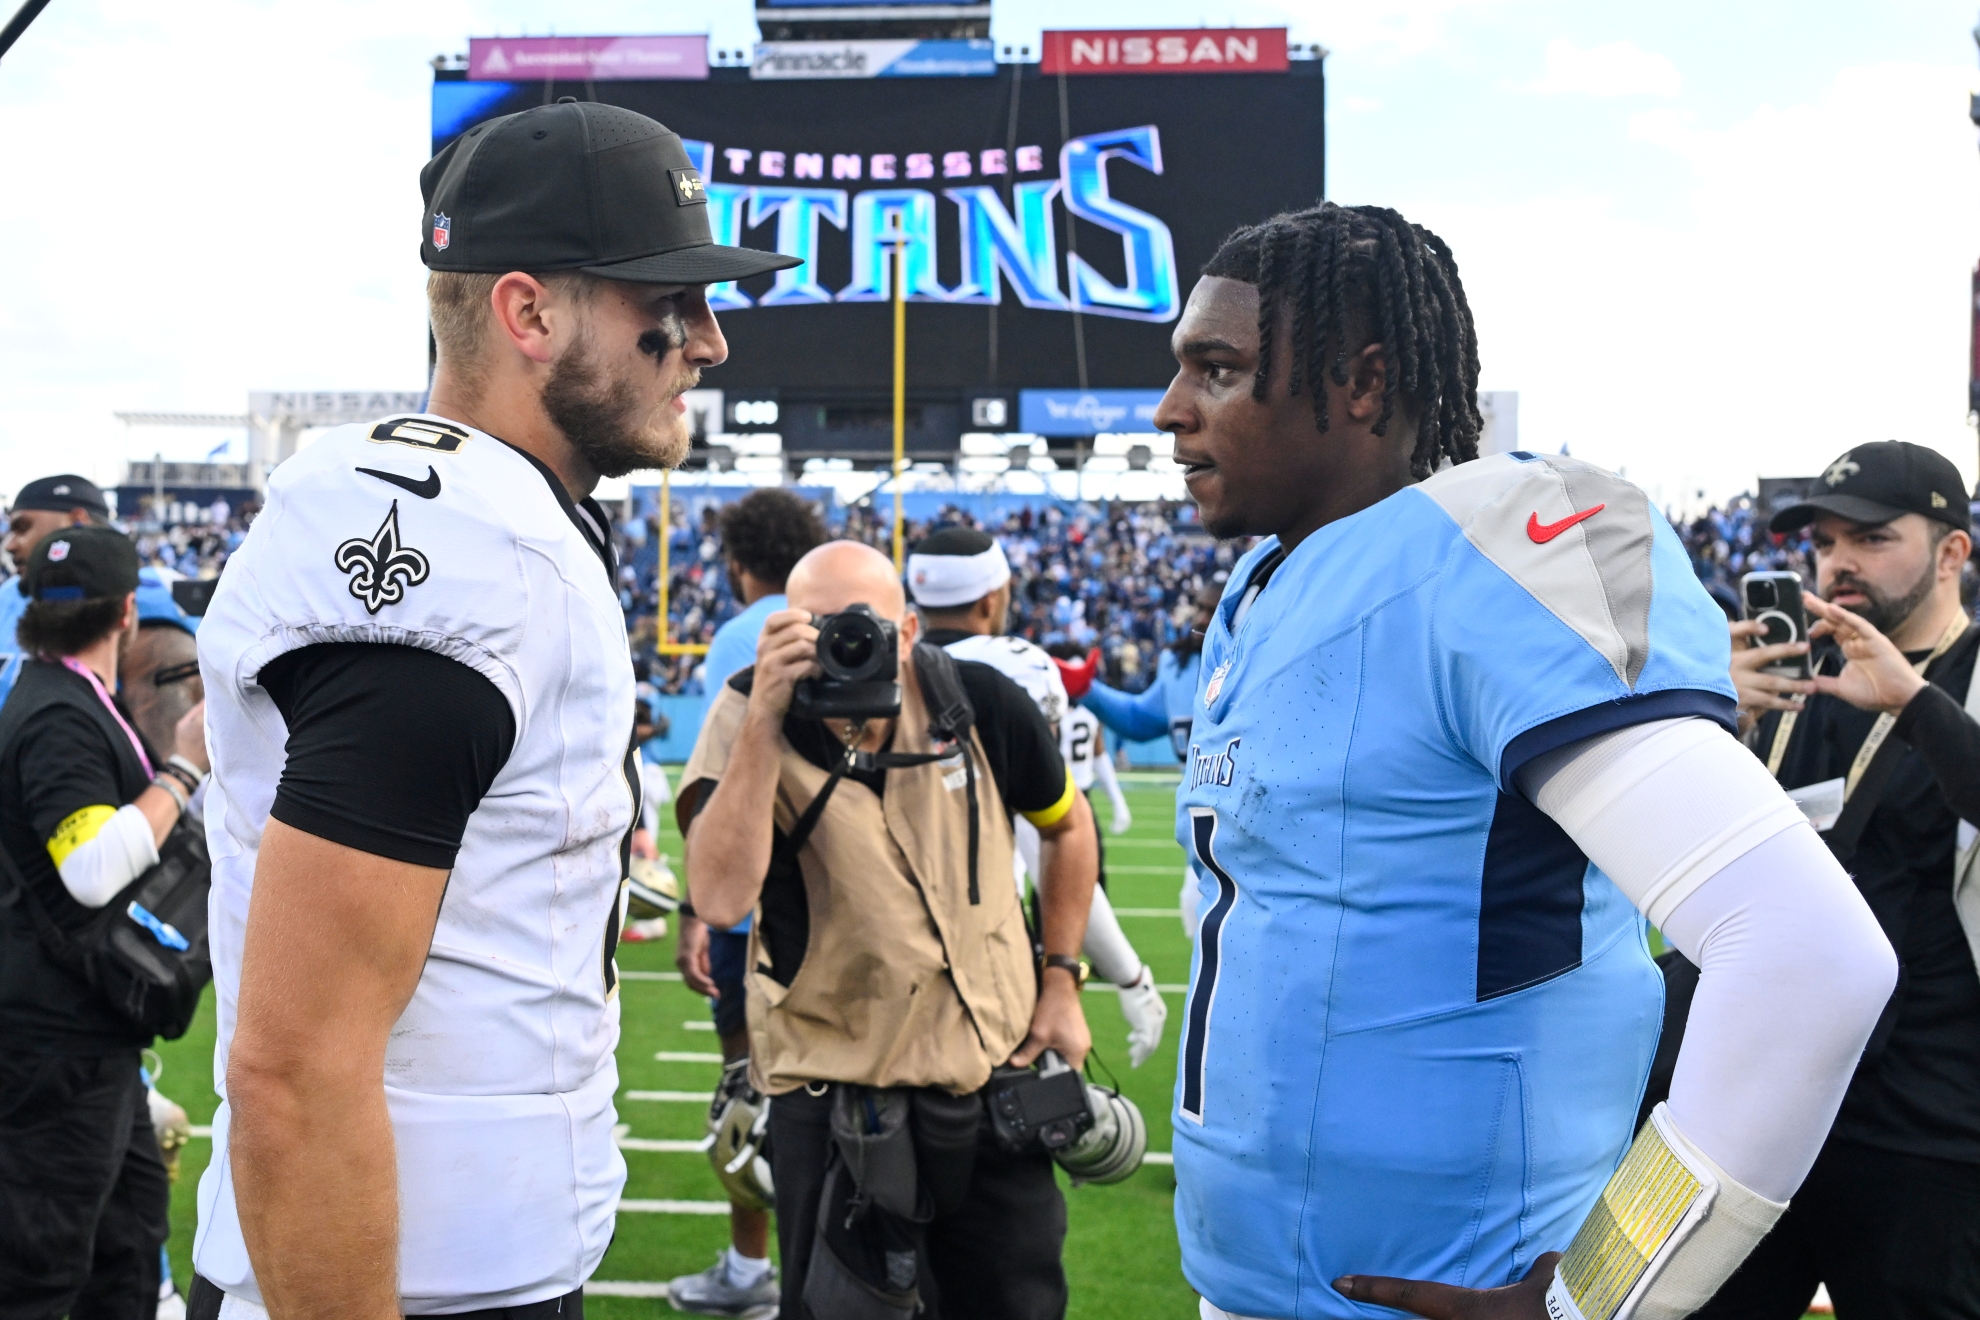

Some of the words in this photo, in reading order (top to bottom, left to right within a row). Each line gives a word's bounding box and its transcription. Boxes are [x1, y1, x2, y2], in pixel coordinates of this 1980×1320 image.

[1071, 36, 1259, 65] NISSAN
[723, 146, 1043, 182] TENNESSEE
[1178, 805, 1238, 1127] 1
